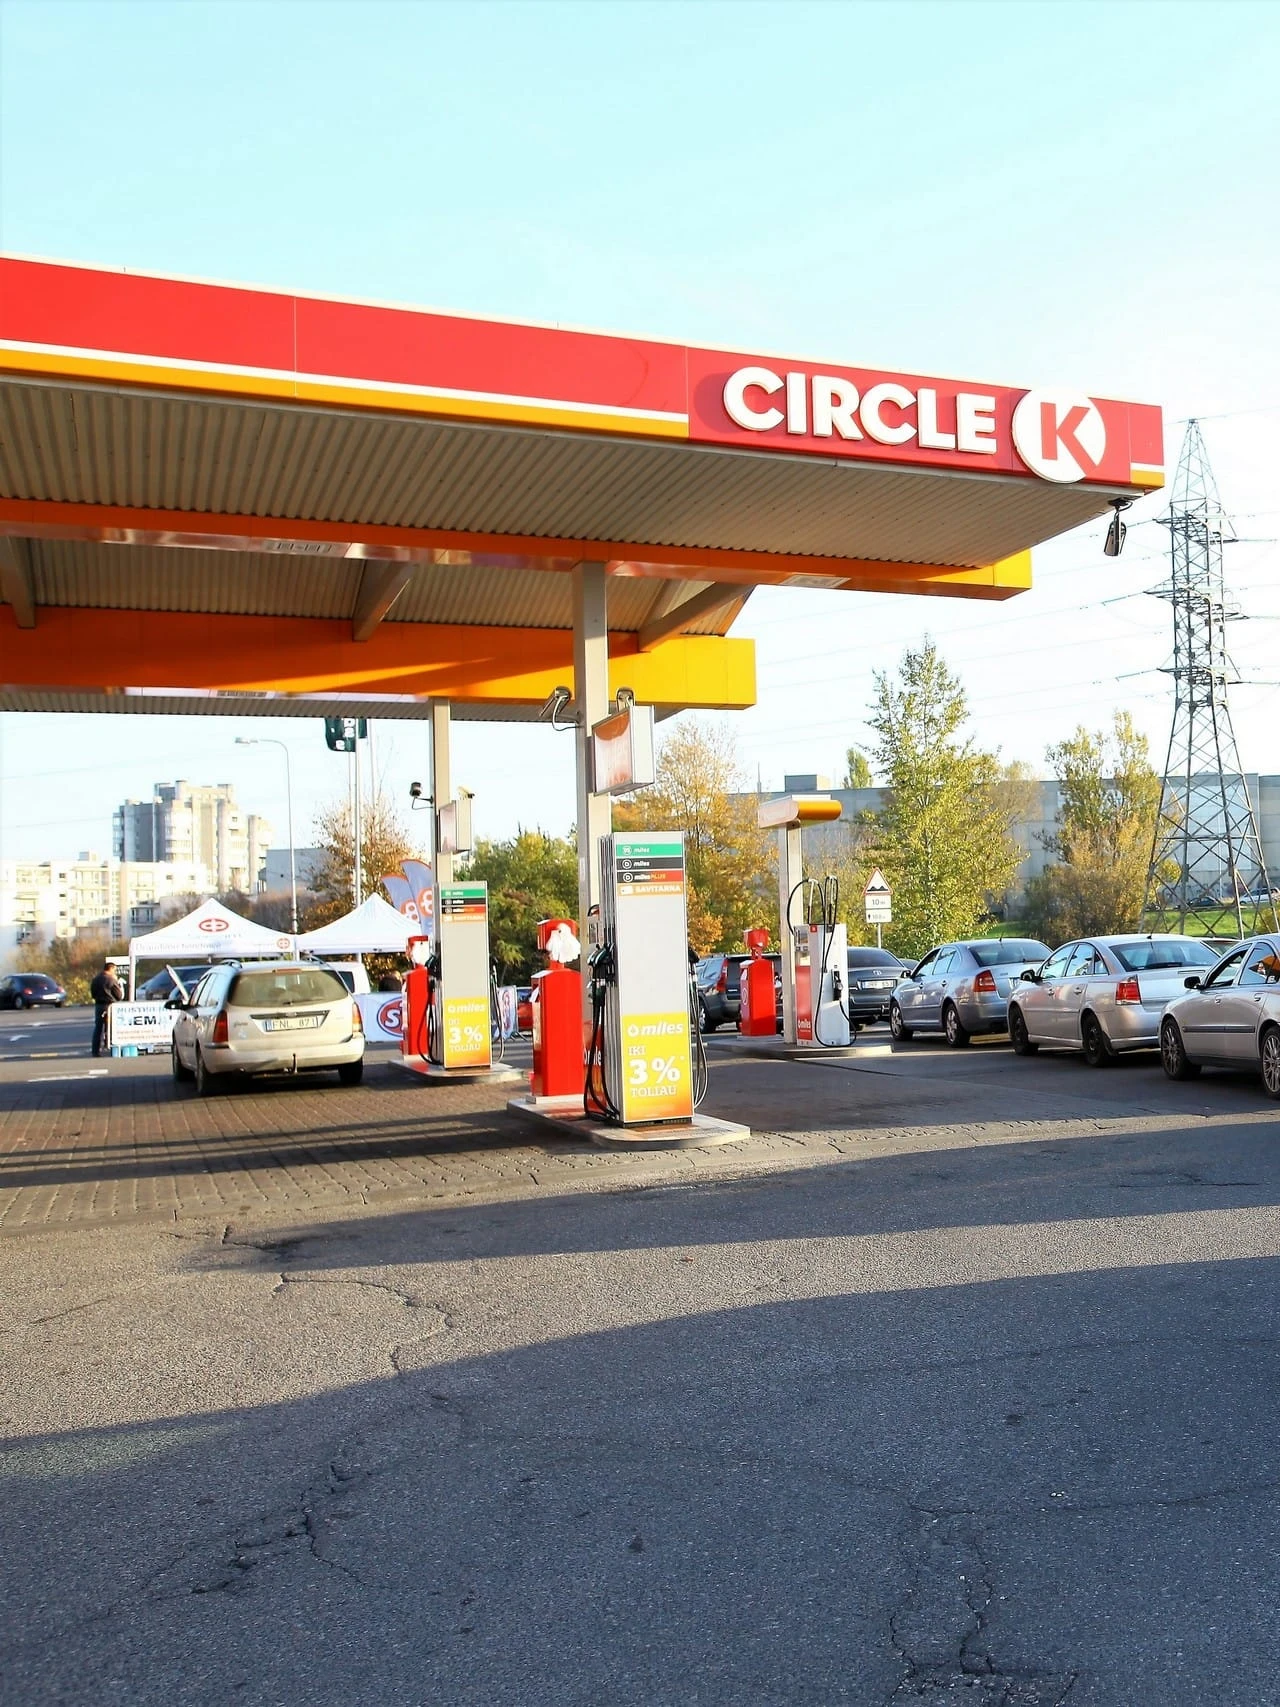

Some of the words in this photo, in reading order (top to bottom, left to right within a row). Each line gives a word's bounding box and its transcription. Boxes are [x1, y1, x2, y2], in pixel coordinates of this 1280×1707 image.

[723, 366, 997, 455] CIRCLE
[1038, 401, 1101, 477] K
[641, 1021, 683, 1036] miles
[628, 1045, 646, 1056] IKI
[631, 1086, 677, 1098] TOLIAU
